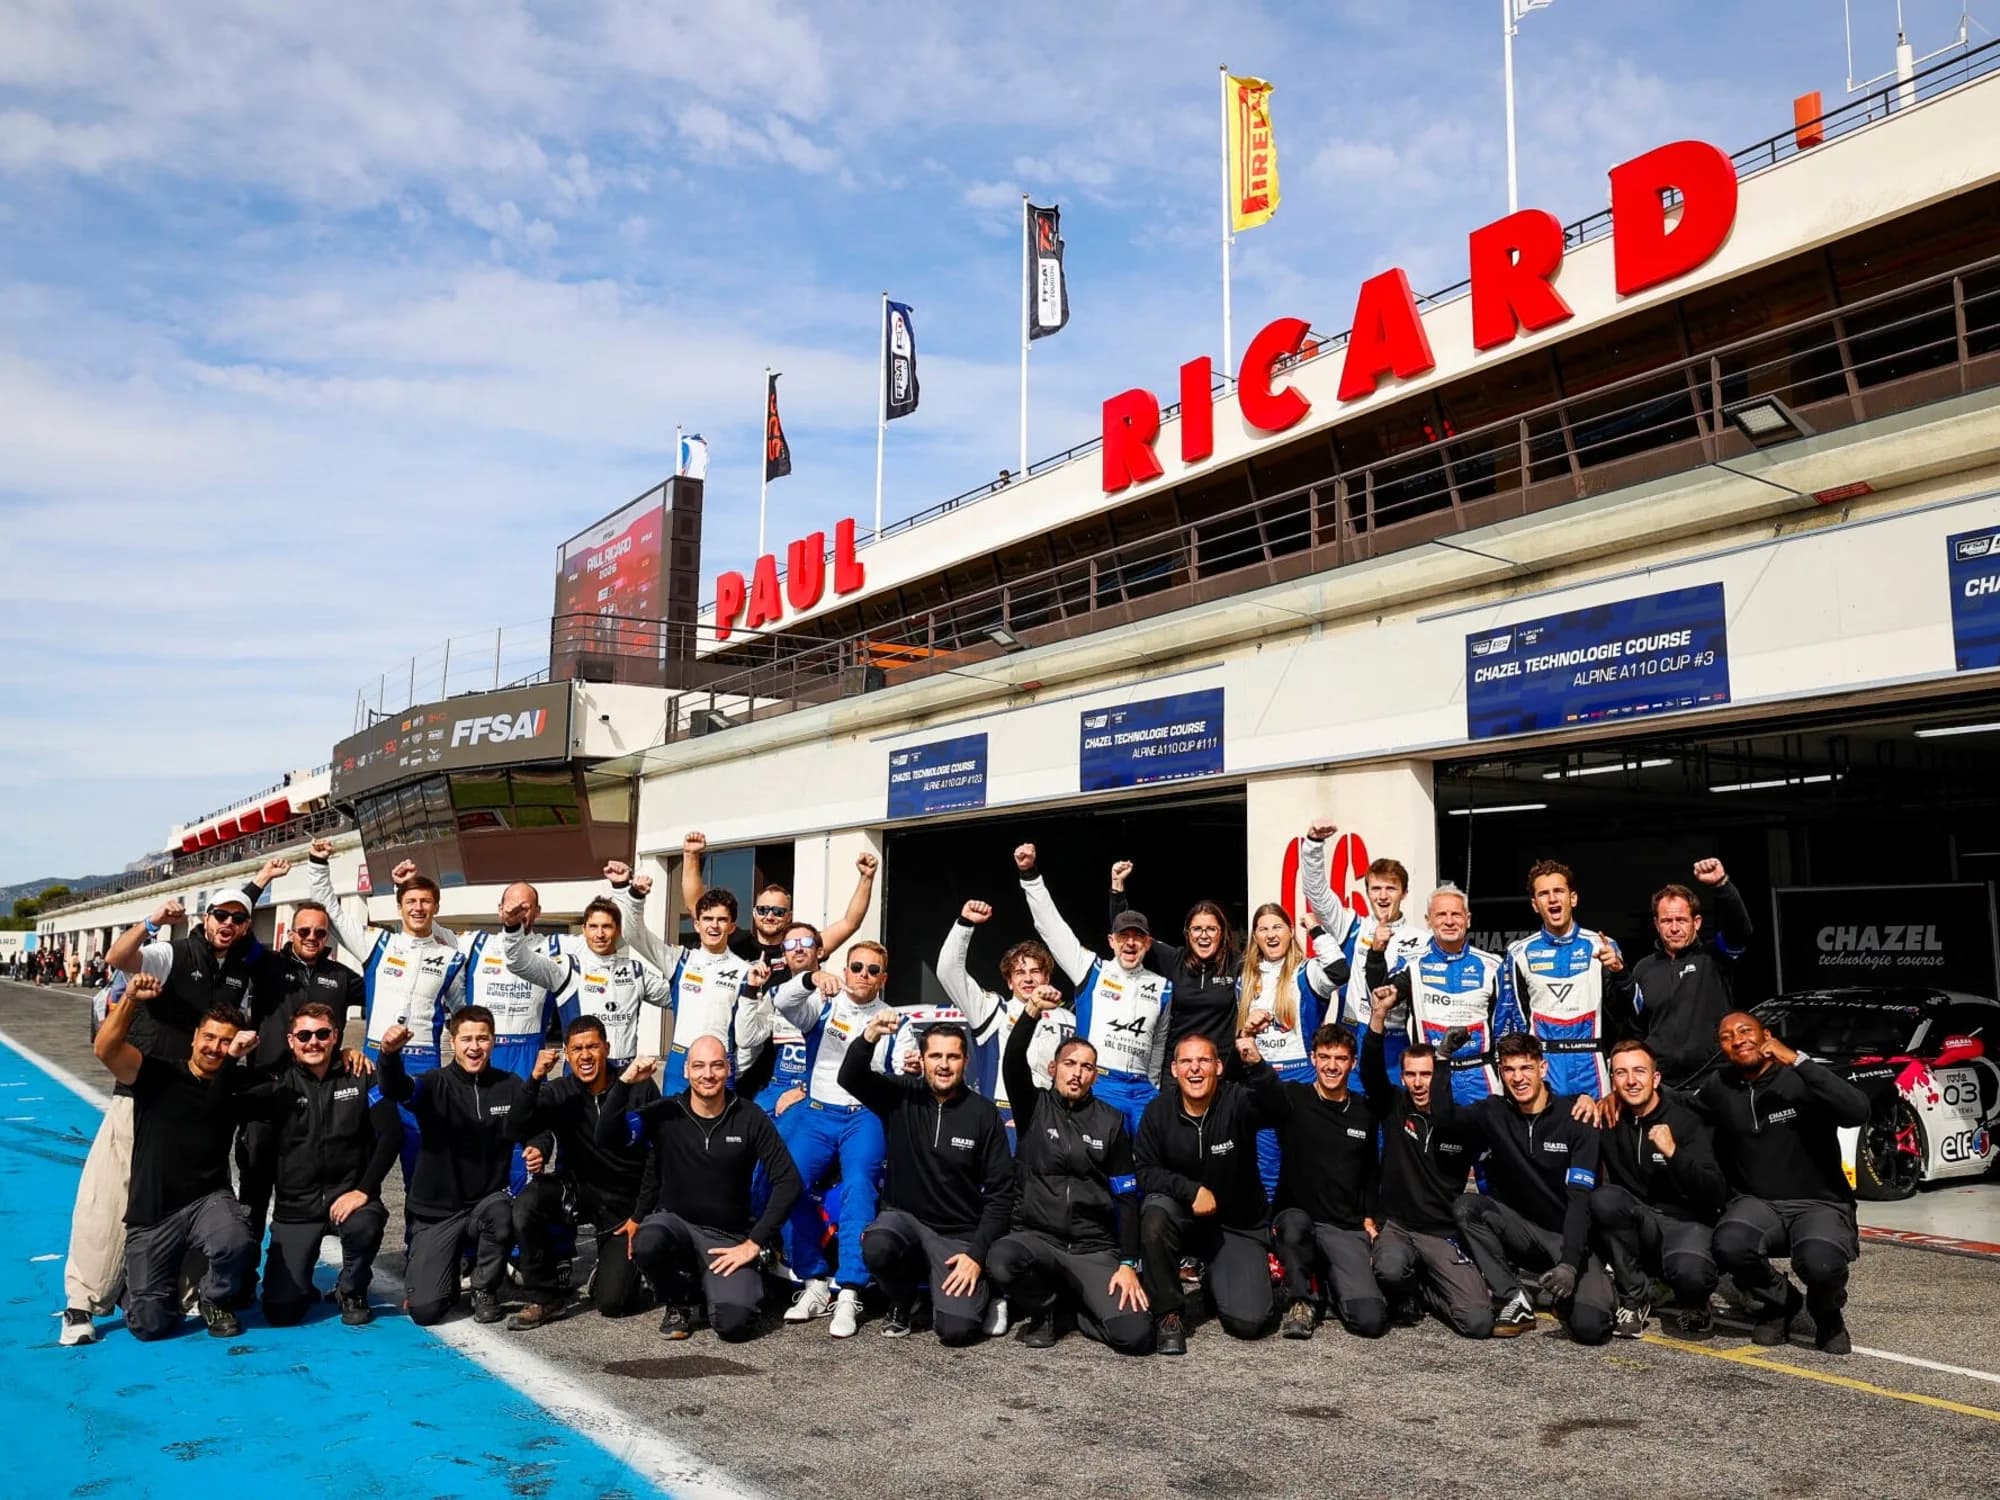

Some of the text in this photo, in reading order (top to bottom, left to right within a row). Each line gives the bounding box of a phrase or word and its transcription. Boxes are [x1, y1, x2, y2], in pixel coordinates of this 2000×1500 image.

[716, 140, 1738, 640] PAUL RICARD
[1474, 661, 1522, 683] CHAZEL
[1525, 643, 1621, 674] TECHNOLOGIE
[1625, 630, 1691, 655] COURSE
[1573, 651, 1714, 687] ALPINE A110 CUP #3
[451, 709, 540, 748] FFSA
[1084, 721, 1206, 749] CHAZEL TECHNOLOGIE COURSE
[1132, 737, 1217, 760] ALPINE A110 CUP #111
[950, 760, 976, 773] COURSE
[1817, 925, 1942, 951] CHAZEL
[1819, 952, 1944, 969] technologie course
[1424, 995, 1451, 1006] RRG
[1943, 1082, 1977, 1105] 03
[1768, 1108, 1796, 1120] CHAZEL
[1941, 1129, 1974, 1162] elf
